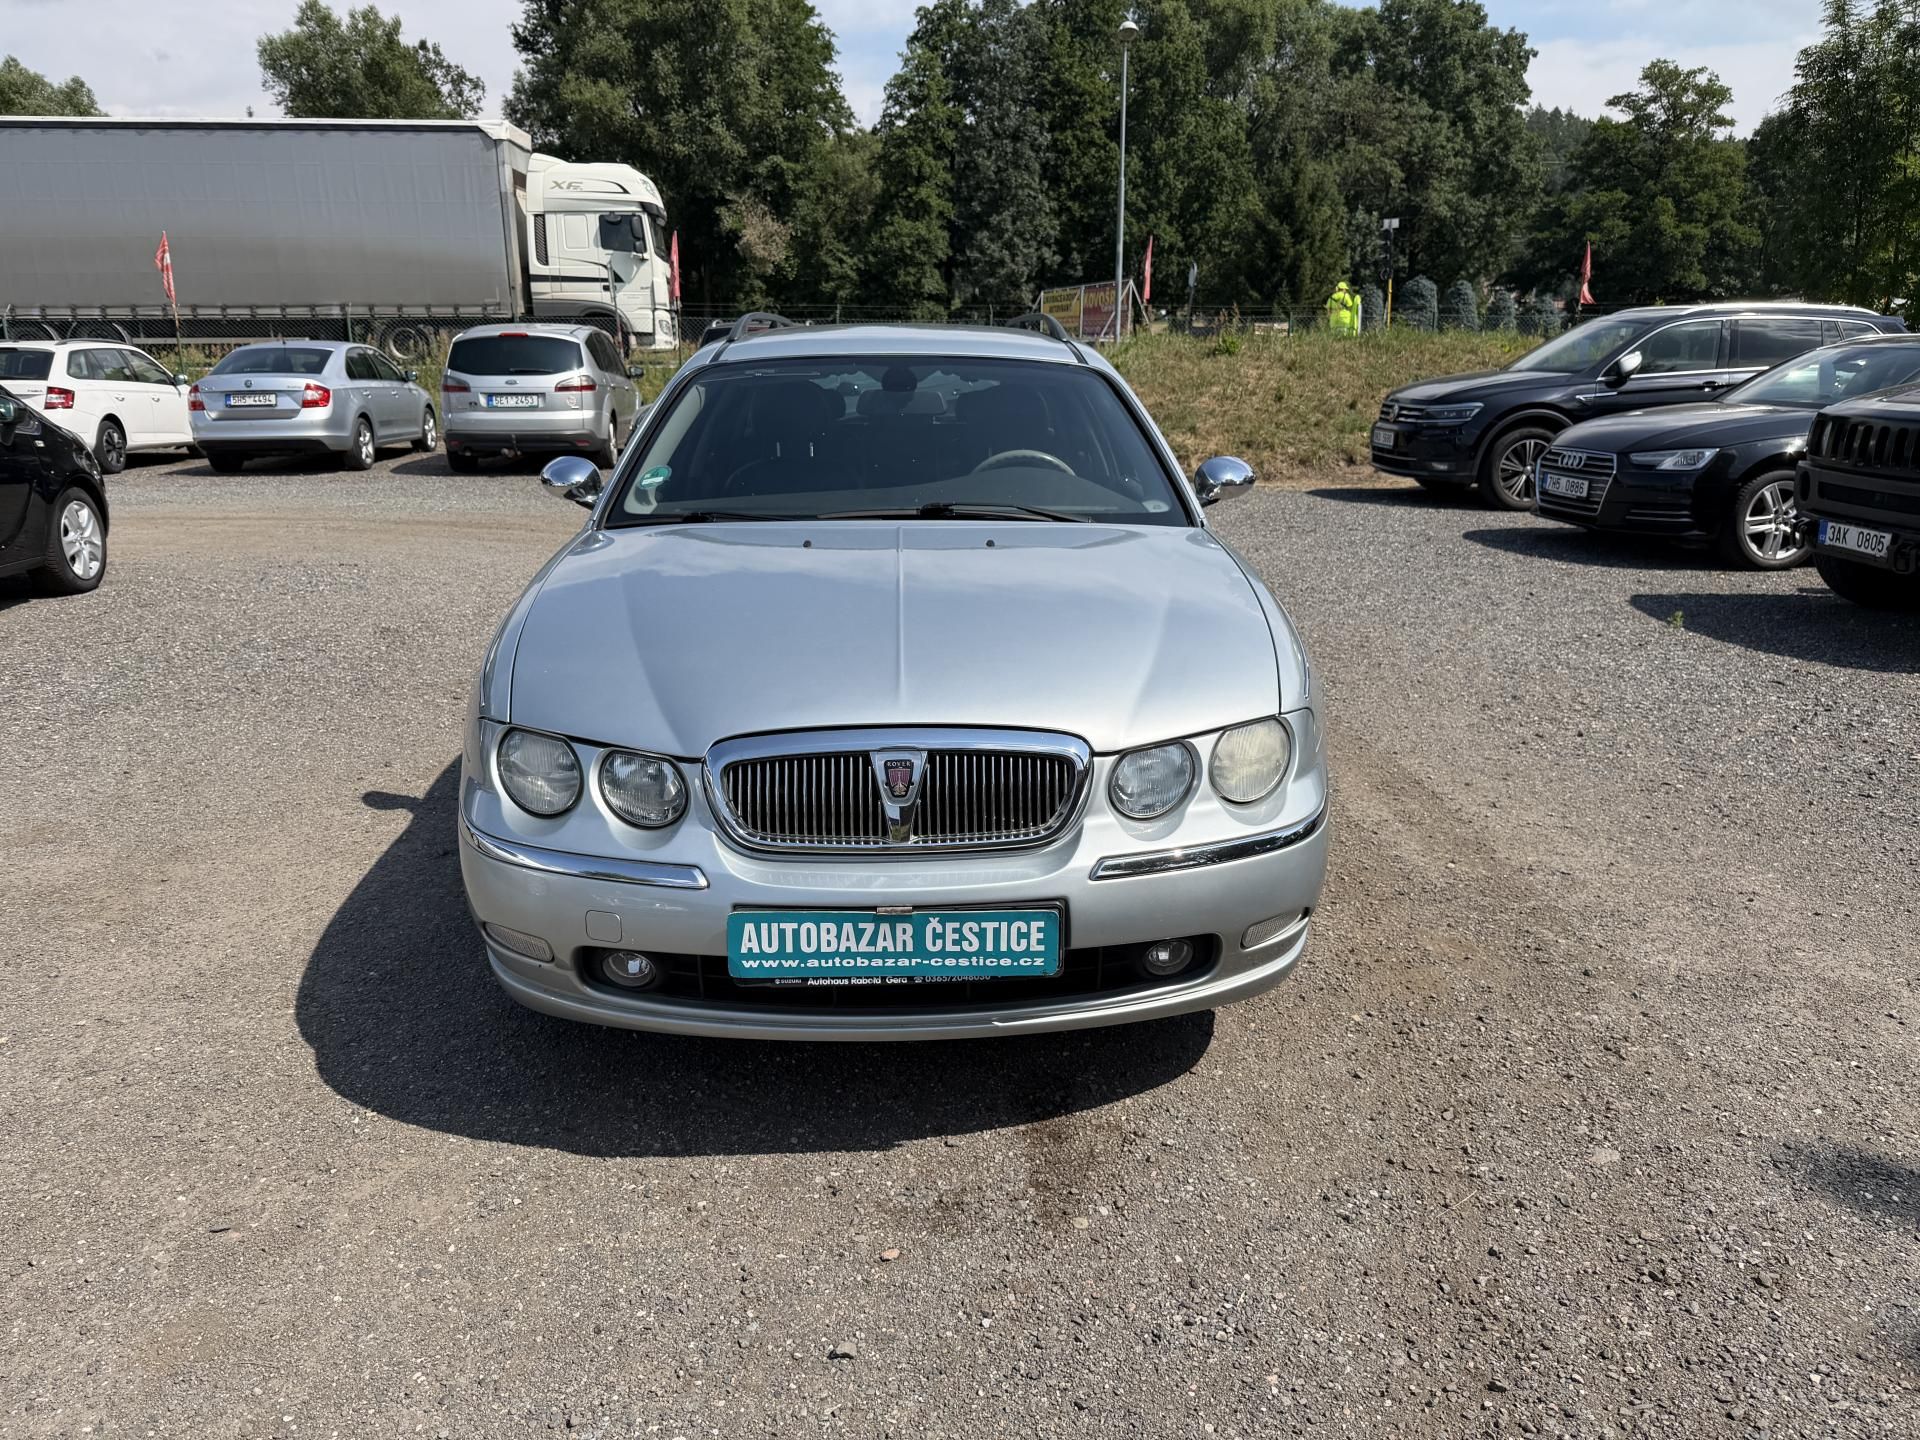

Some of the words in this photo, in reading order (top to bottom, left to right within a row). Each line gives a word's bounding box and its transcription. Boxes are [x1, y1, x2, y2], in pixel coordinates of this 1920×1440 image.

[1828, 525, 1849, 545] 3AK
[1856, 531, 1886, 552] 0805
[740, 922, 914, 954] AUTOBAZAR
[925, 918, 1045, 952] ČESTICE
[741, 956, 1045, 968] www.autobazar-cestice.cz
[807, 977, 849, 985] Autohaus
[851, 976, 881, 985] Rabold
[886, 976, 908, 984] Gera
